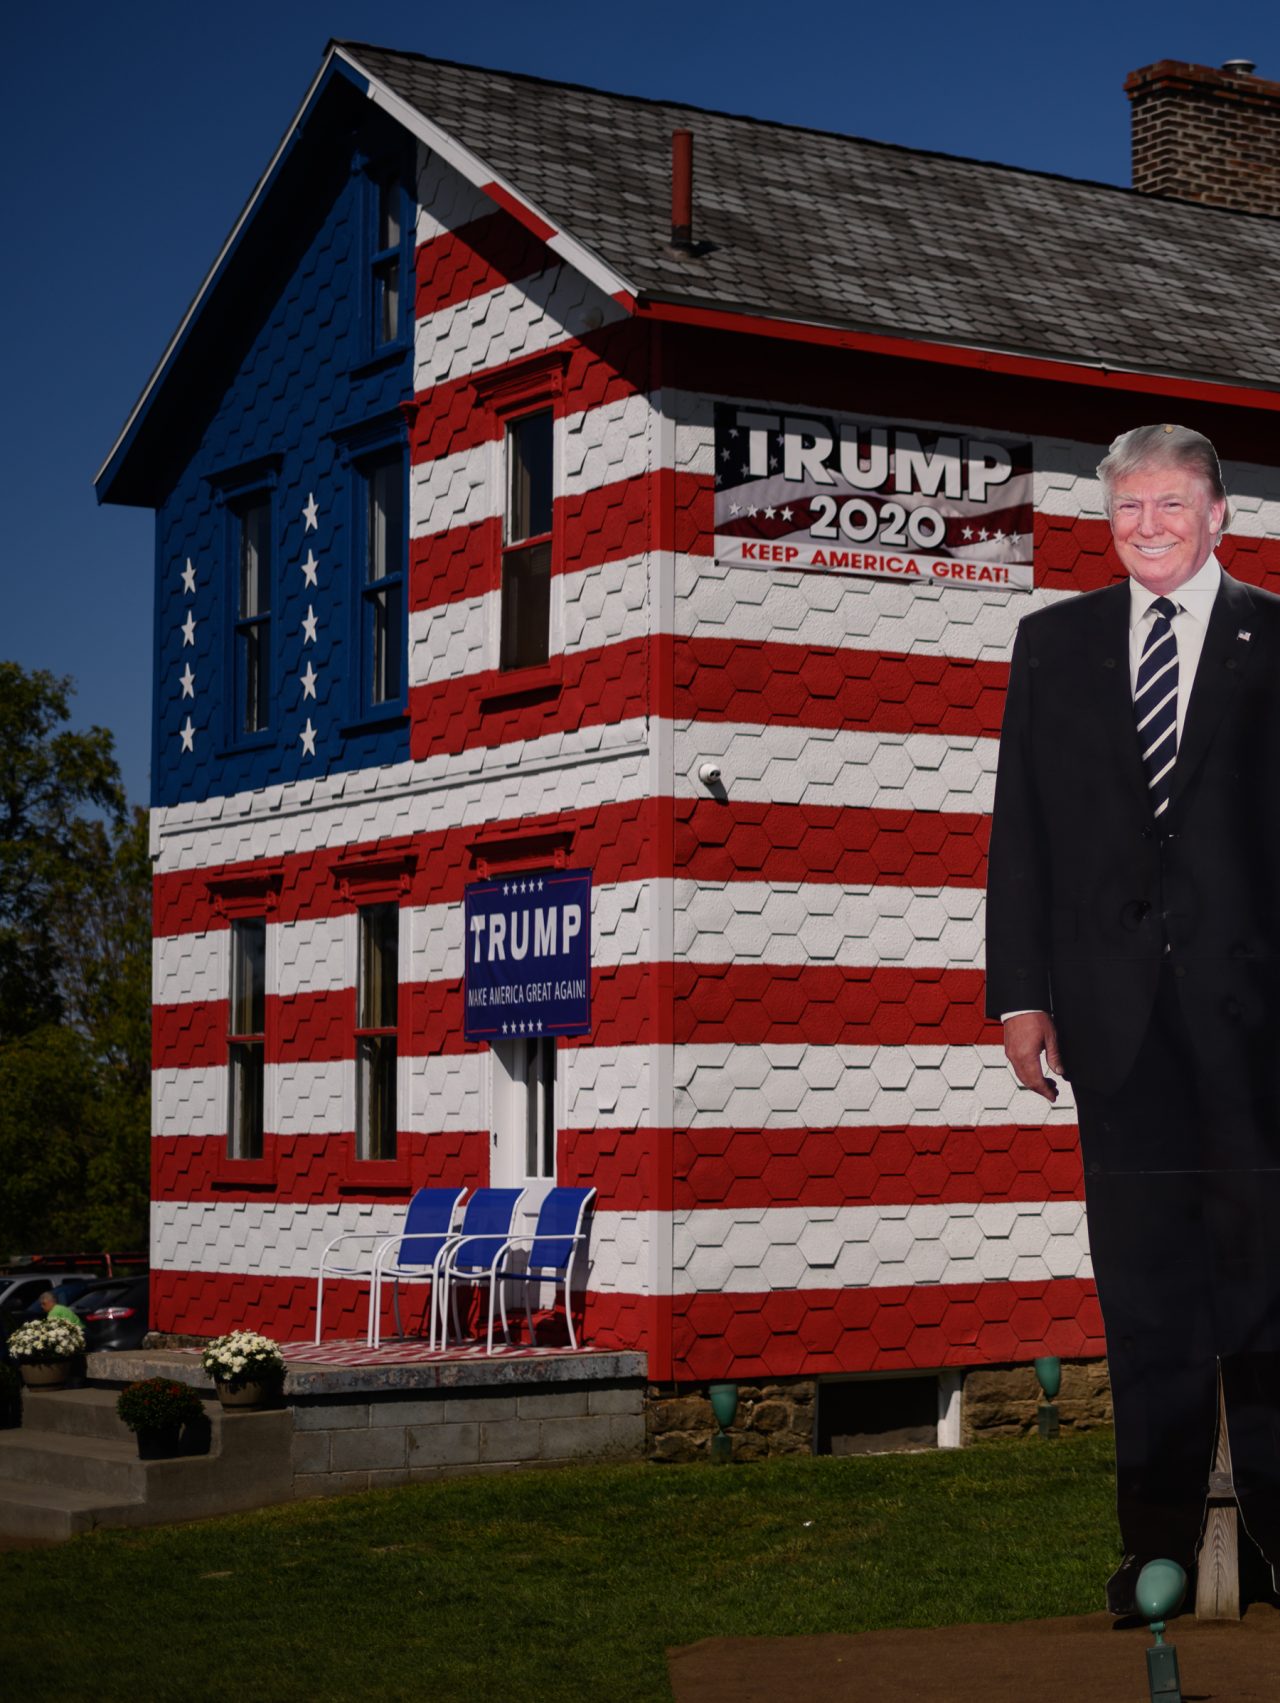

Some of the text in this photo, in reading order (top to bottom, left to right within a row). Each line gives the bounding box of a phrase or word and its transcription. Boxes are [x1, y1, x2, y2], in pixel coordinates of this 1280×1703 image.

[736, 411, 1013, 502] TRUMP
[809, 495, 946, 549] 2020
[741, 543, 1010, 584] KEEP AMERICA GREAT!
[470, 904, 582, 963] TRUMP
[468, 980, 586, 1007] MAKE AMERICA GREAT AGAIN!
